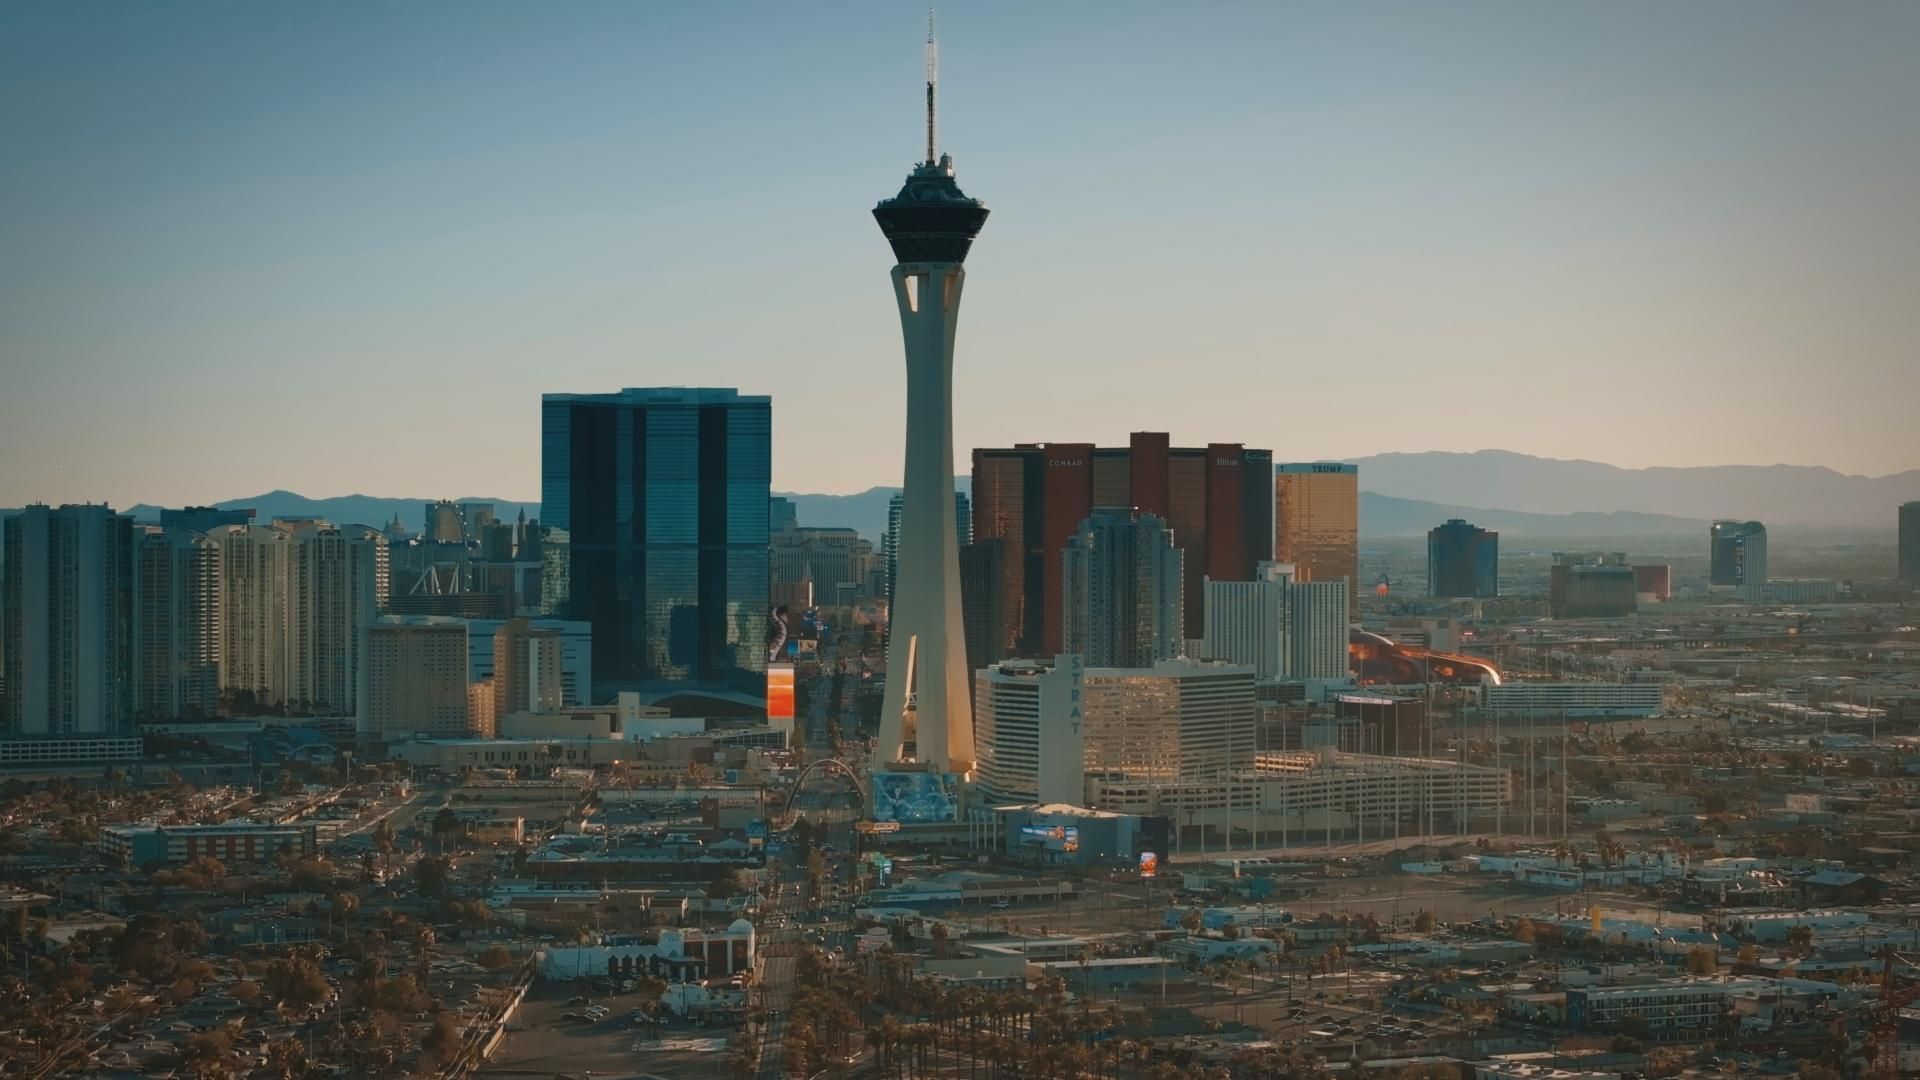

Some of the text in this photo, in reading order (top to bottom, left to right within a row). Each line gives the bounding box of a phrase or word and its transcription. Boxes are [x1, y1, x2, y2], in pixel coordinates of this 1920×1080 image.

[1048, 459, 1083, 467] CONRAD
[1216, 457, 1239, 466] Hilton
[1312, 465, 1342, 473] TRUMP
[1071, 656, 1081, 735] STRAT
